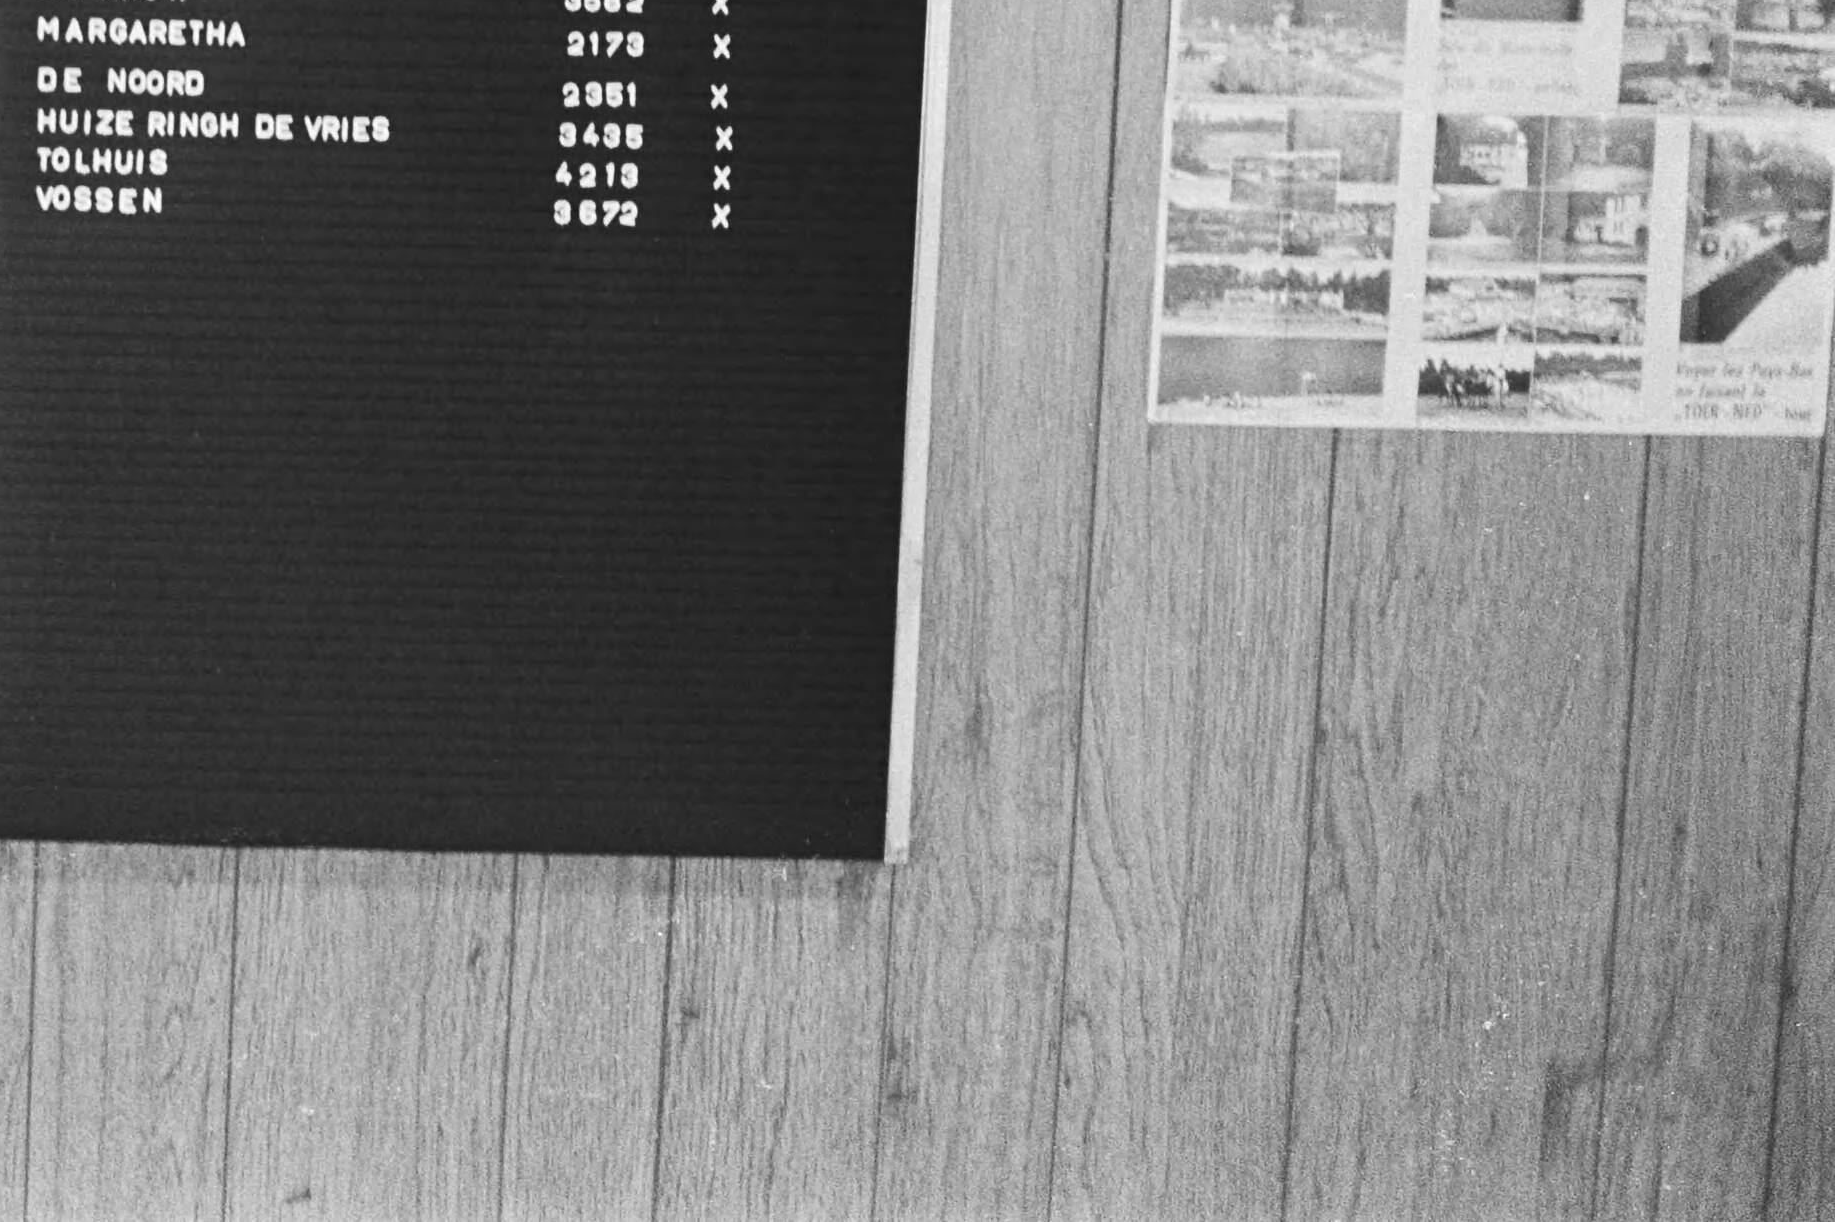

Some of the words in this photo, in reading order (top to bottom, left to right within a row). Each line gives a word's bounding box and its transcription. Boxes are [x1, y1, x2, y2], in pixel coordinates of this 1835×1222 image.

[36, 15, 246, 48] MARGARETHA
[566, 30, 645, 59] 2173
[36, 65, 83, 94] DE
[106, 67, 205, 98] NOORD
[561, 80, 637, 109] 2351
[36, 107, 134, 137] HUIZE
[147, 110, 240, 139] RINGH
[254, 112, 294, 142] DE
[303, 114, 391, 143] VRIES
[558, 121, 644, 150] 3435
[36, 145, 168, 176] TOLHUIS
[555, 160, 639, 190] 4213
[35, 183, 163, 216] VOSSEN
